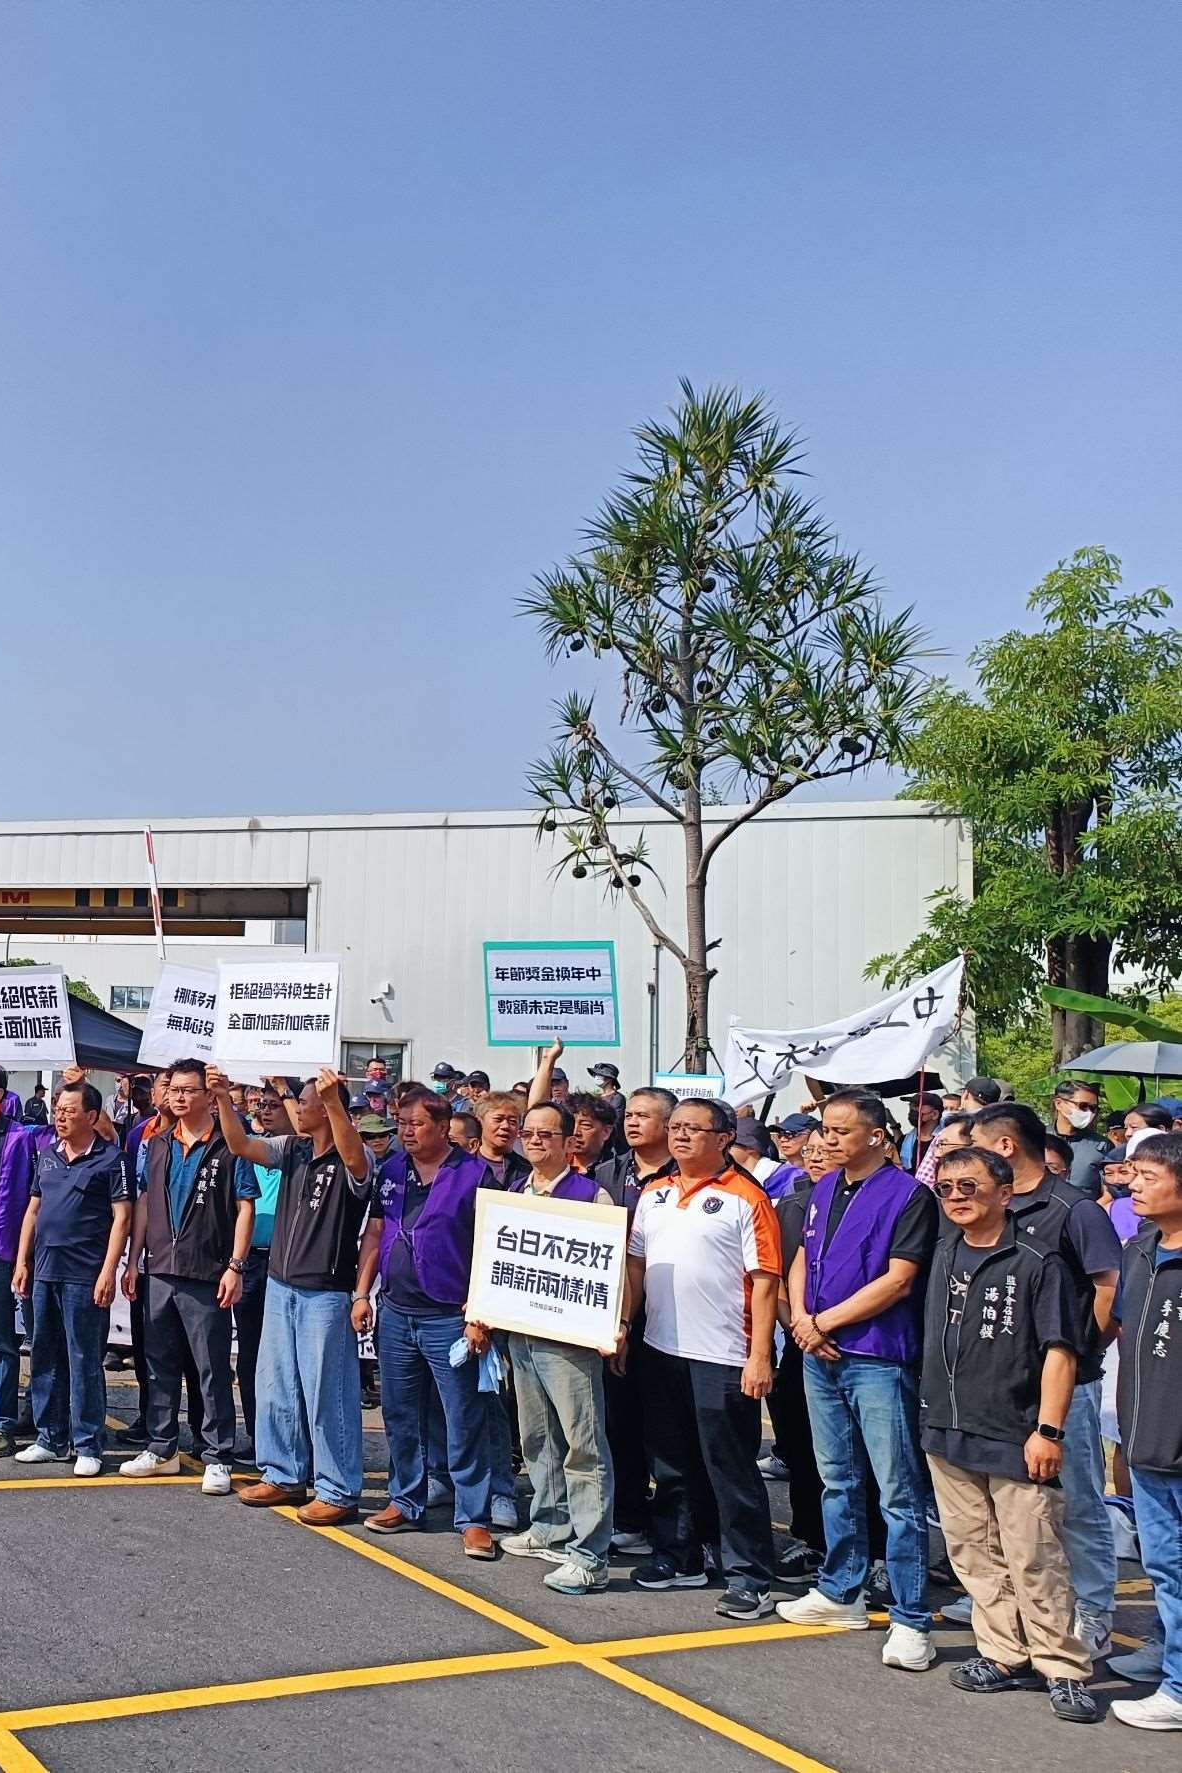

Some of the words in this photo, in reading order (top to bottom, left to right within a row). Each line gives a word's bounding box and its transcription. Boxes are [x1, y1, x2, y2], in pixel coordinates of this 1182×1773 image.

[494, 966, 602, 982] 年節獎金換年中
[229, 982, 333, 1000] 拒絕過勞換生計
[227, 1013, 331, 1032] 全面加薪加底薪
[496, 1225, 615, 1271] 台日不友好
[490, 1260, 610, 1310] 調薪兩樣情
